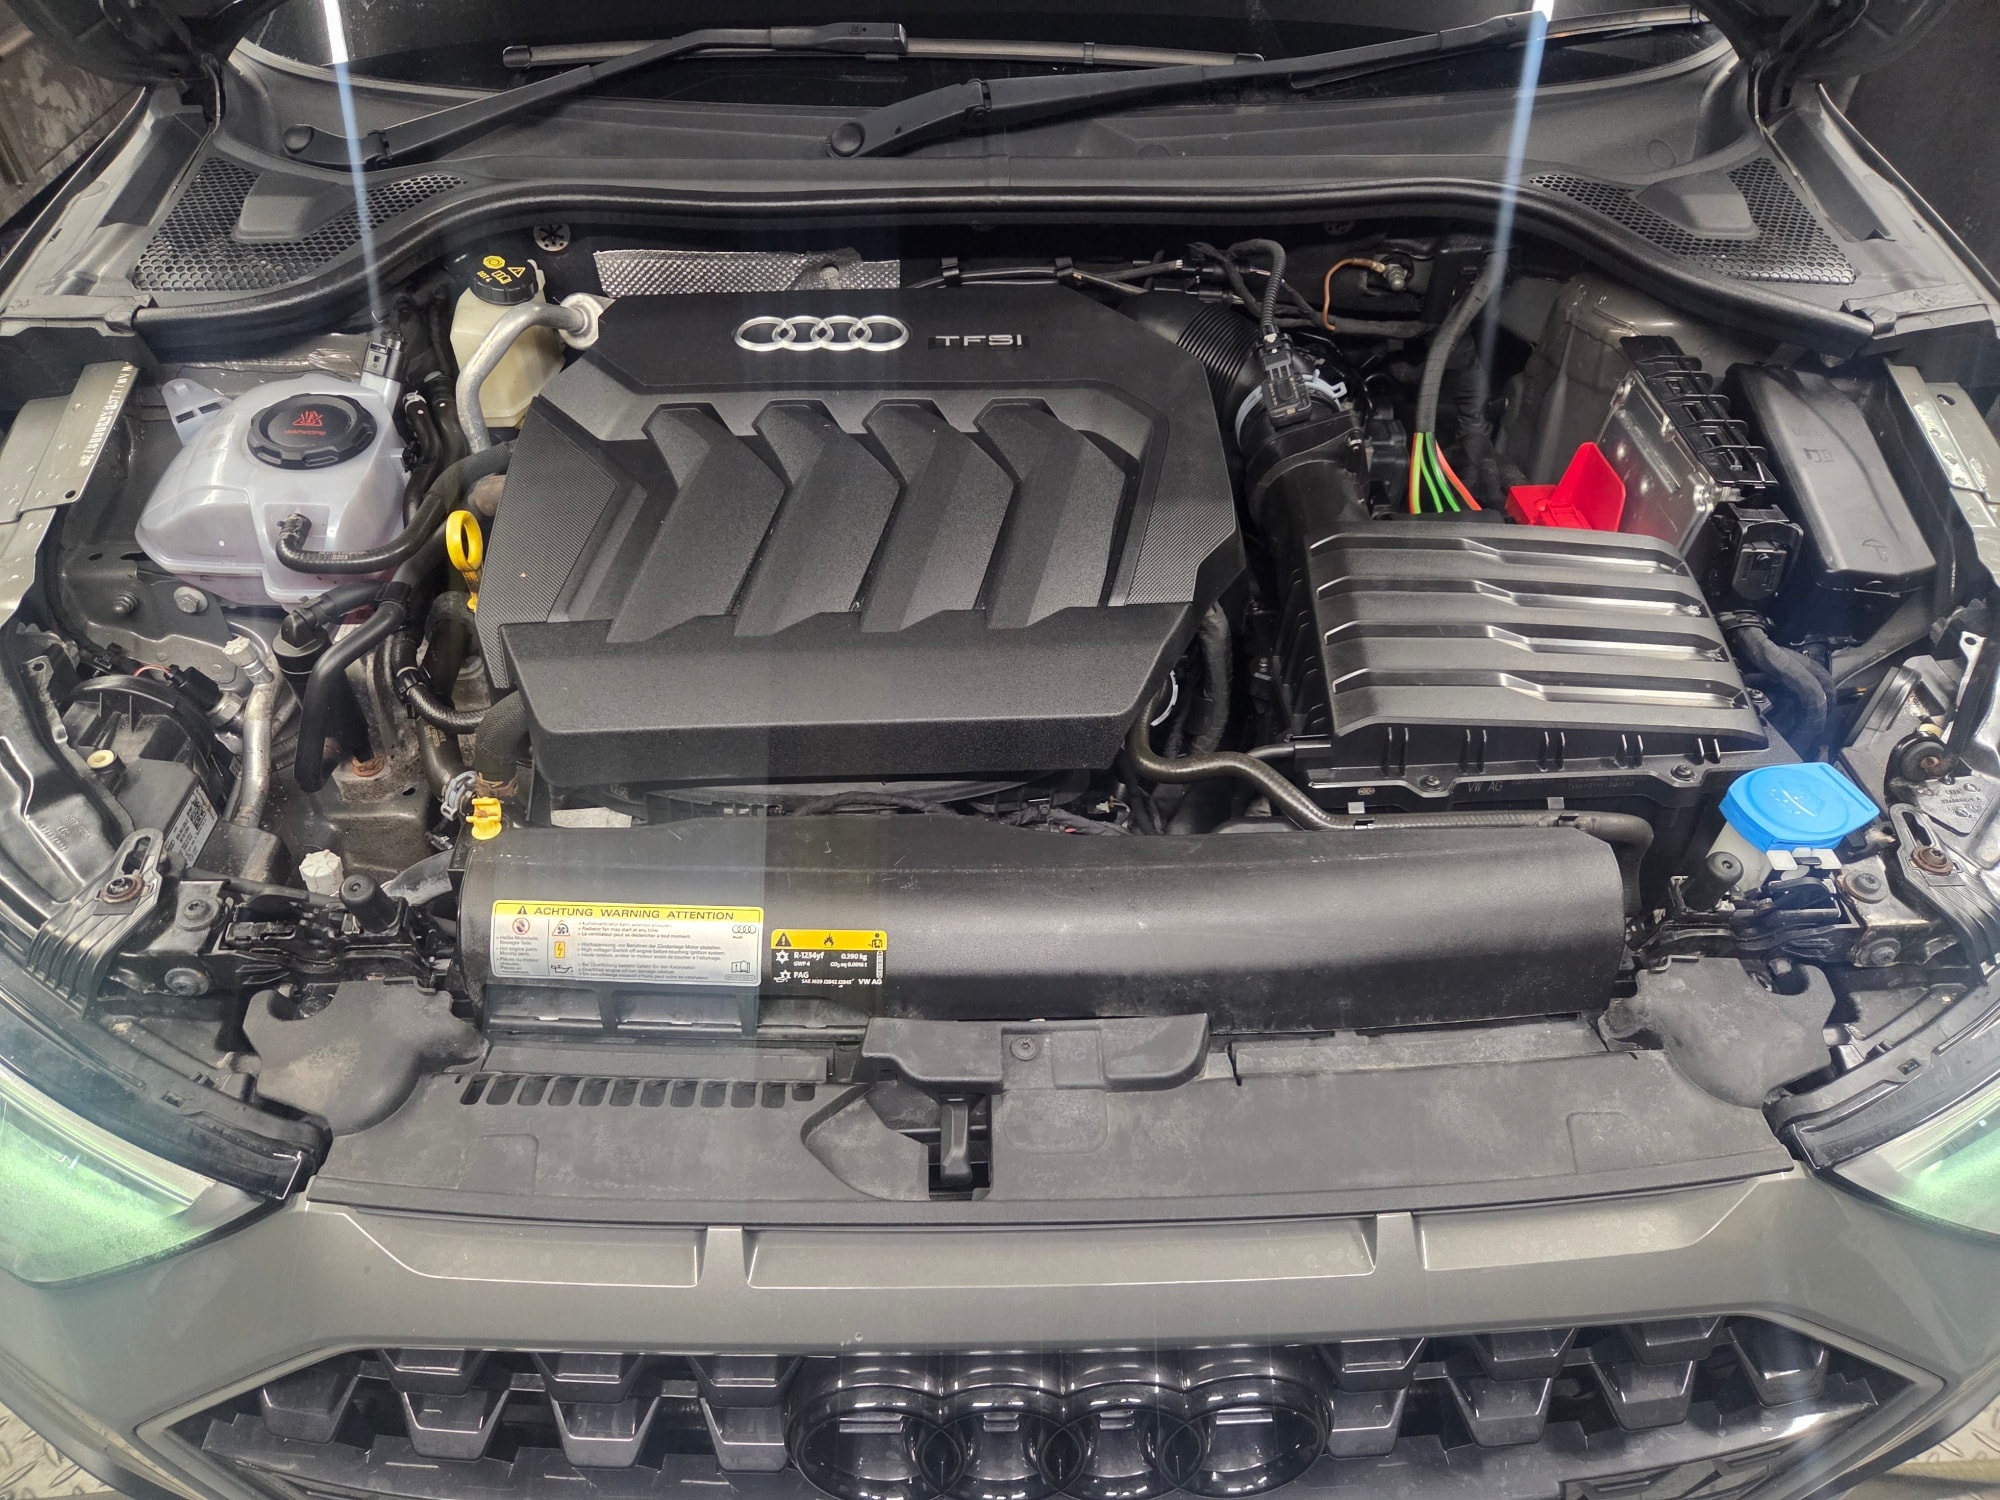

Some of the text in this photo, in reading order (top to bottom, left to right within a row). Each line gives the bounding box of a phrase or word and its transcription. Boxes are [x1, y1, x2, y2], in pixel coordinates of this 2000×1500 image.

[936, 334, 1022, 346] TFSI
[1468, 782, 1482, 792] VW
[1487, 781, 1502, 792] AG
[534, 906, 734, 920] ACHTUNG WARNING ATTENTION
[794, 952, 824, 960] R-1234yf
[860, 953, 868, 961] kg
